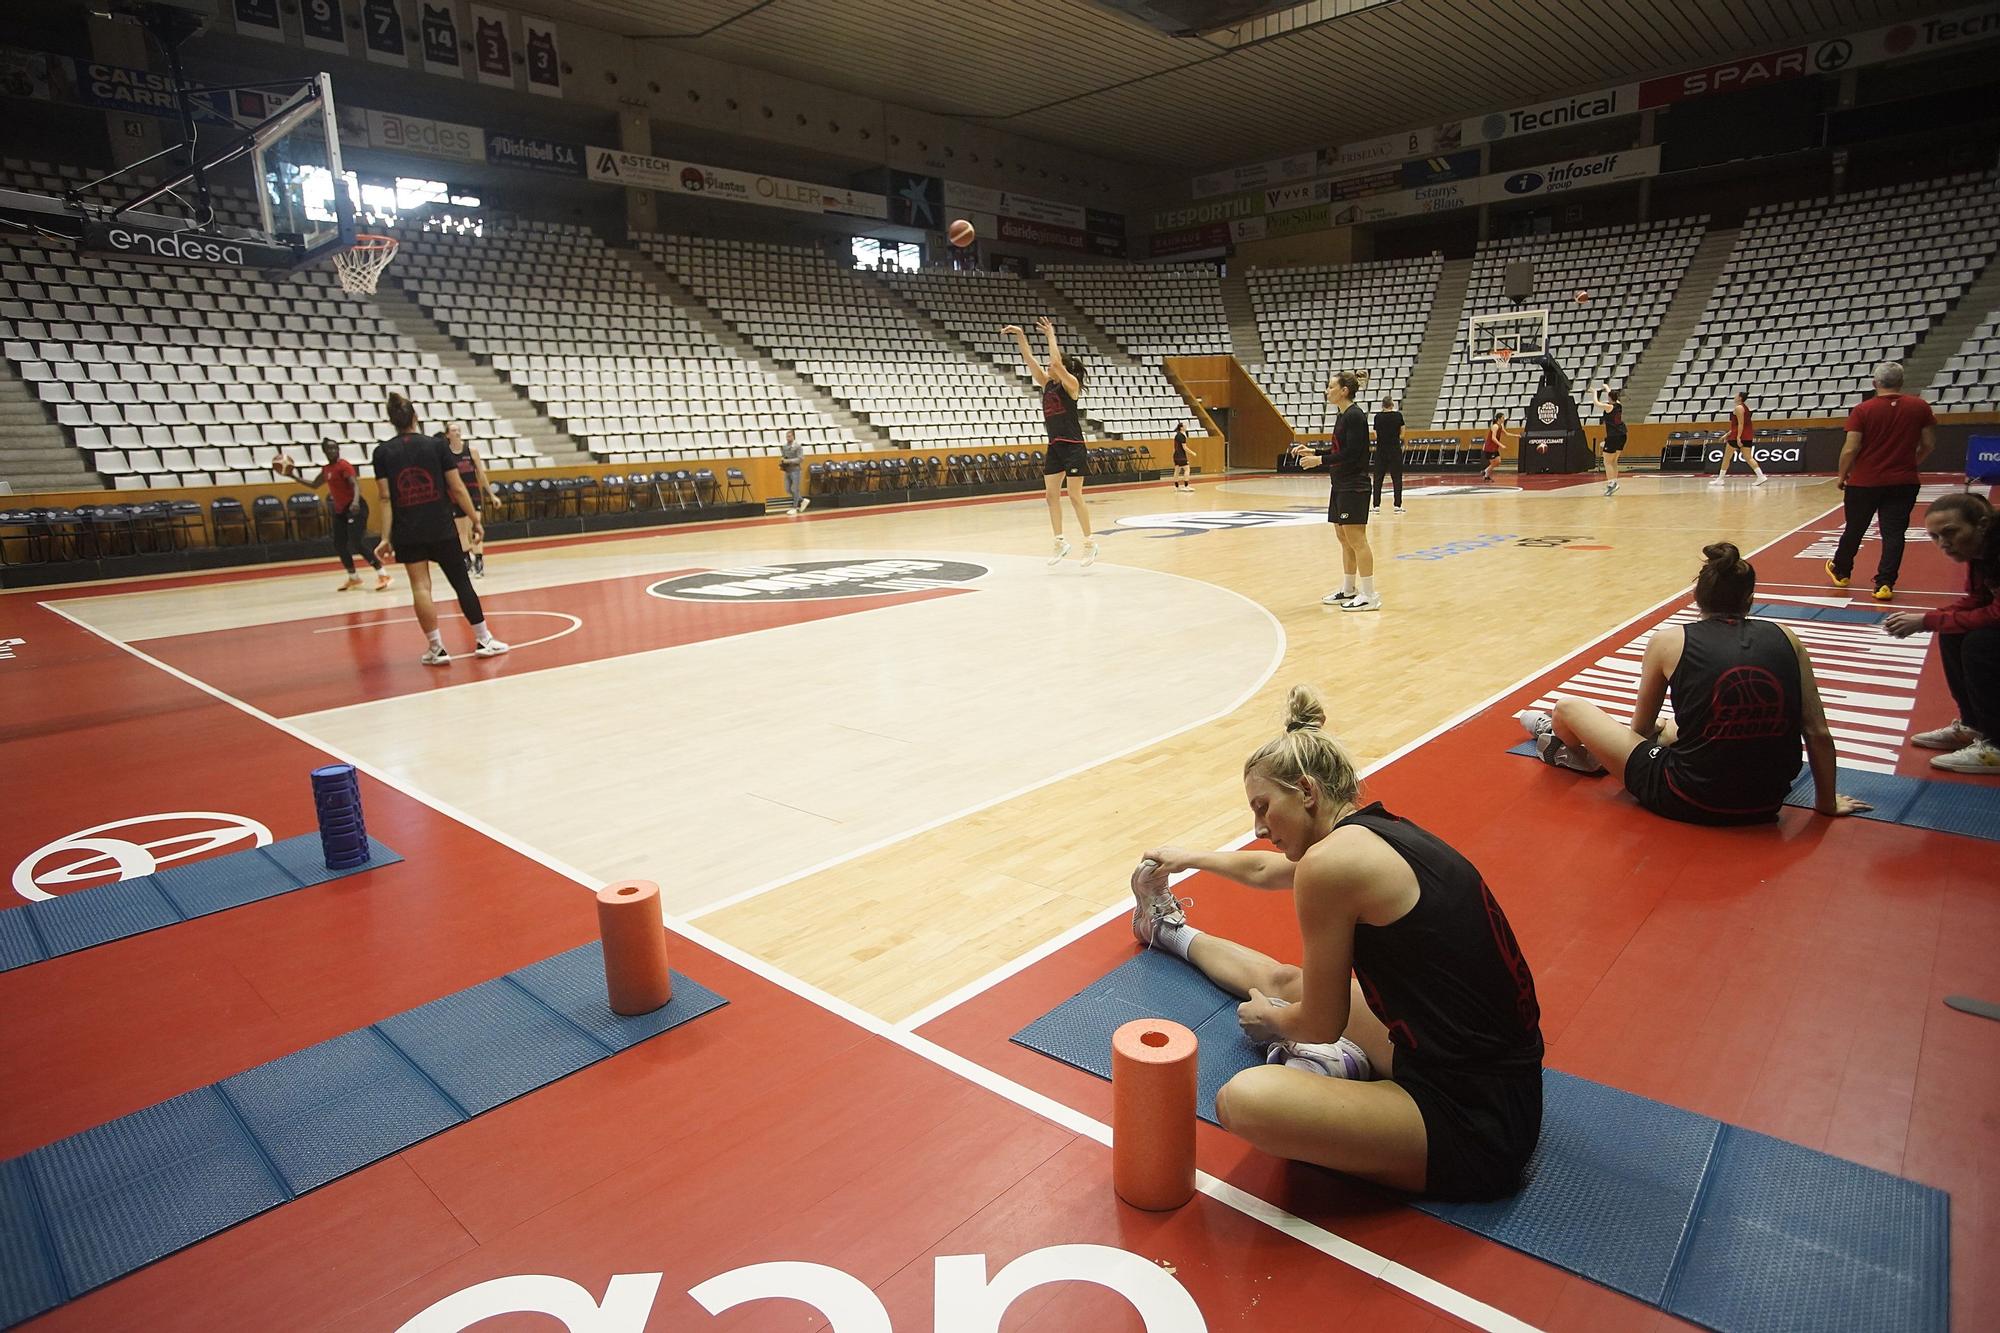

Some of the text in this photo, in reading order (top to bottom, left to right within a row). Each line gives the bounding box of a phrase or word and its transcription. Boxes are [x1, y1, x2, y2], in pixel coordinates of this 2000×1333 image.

[312, 0, 330, 21] 9
[374, 14, 391, 34] 7
[427, 27, 453, 48] 14
[487, 40, 499, 59] 3
[536, 52, 549, 69] 3
[1683, 53, 1803, 95] SPAR
[1510, 91, 1616, 133] Tecnical
[382, 115, 471, 150] aedes
[1547, 155, 1618, 183] infoself
[756, 177, 820, 203] OLLER
[1415, 183, 1457, 202] Estanys
[1546, 180, 1572, 194] group
[1153, 198, 1252, 230] L'ESPORTIU
[109, 229, 244, 265] endesa
